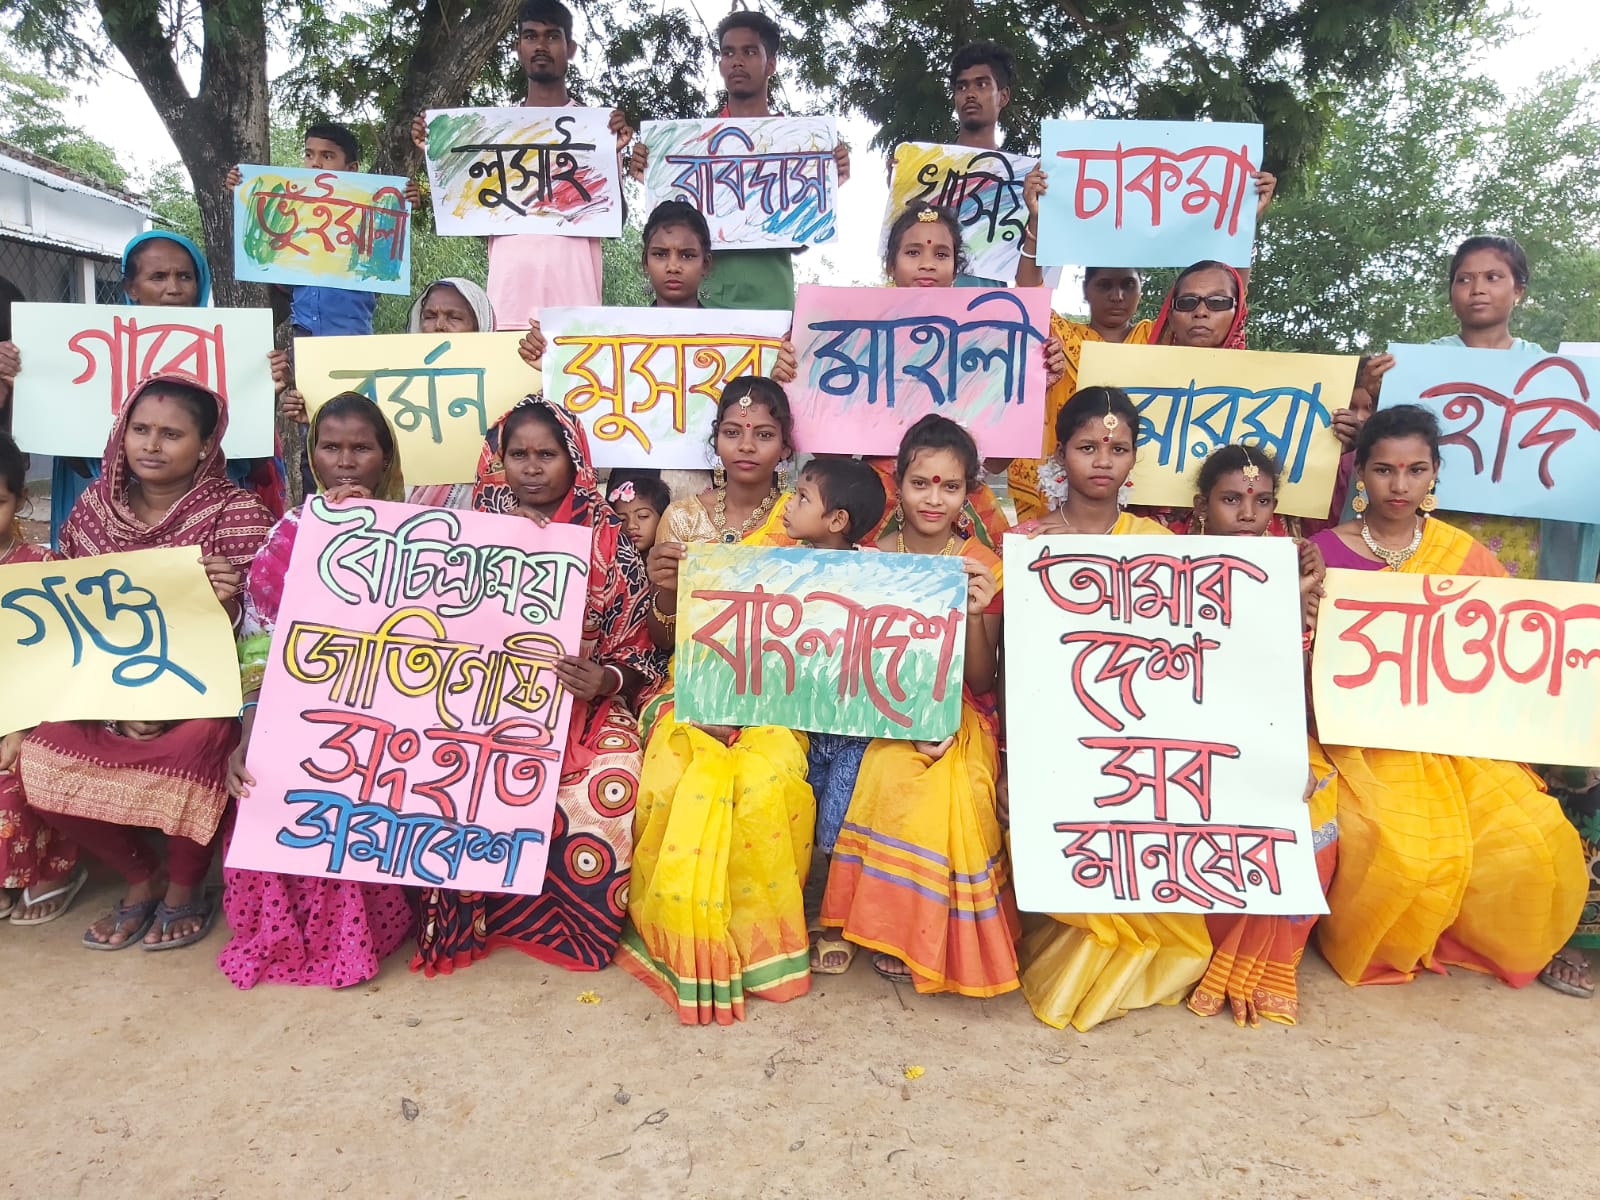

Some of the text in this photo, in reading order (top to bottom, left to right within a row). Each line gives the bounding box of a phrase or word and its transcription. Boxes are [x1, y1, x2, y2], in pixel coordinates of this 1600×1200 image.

[451, 116, 596, 216] লুসাই
[666, 127, 833, 215] রবিদাস
[1056, 141, 1257, 237] চাকমা
[808, 291, 1046, 407] মাহালী
[1028, 545, 1268, 628] আমার
[691, 584, 965, 728] বাংলাদেশ
[1060, 632, 1220, 731] দেশ
[300, 709, 560, 822] সংহতি
[1078, 737, 1240, 821] সব
[276, 789, 544, 887] সমাবেশ
[1053, 820, 1297, 909] মানুষের
